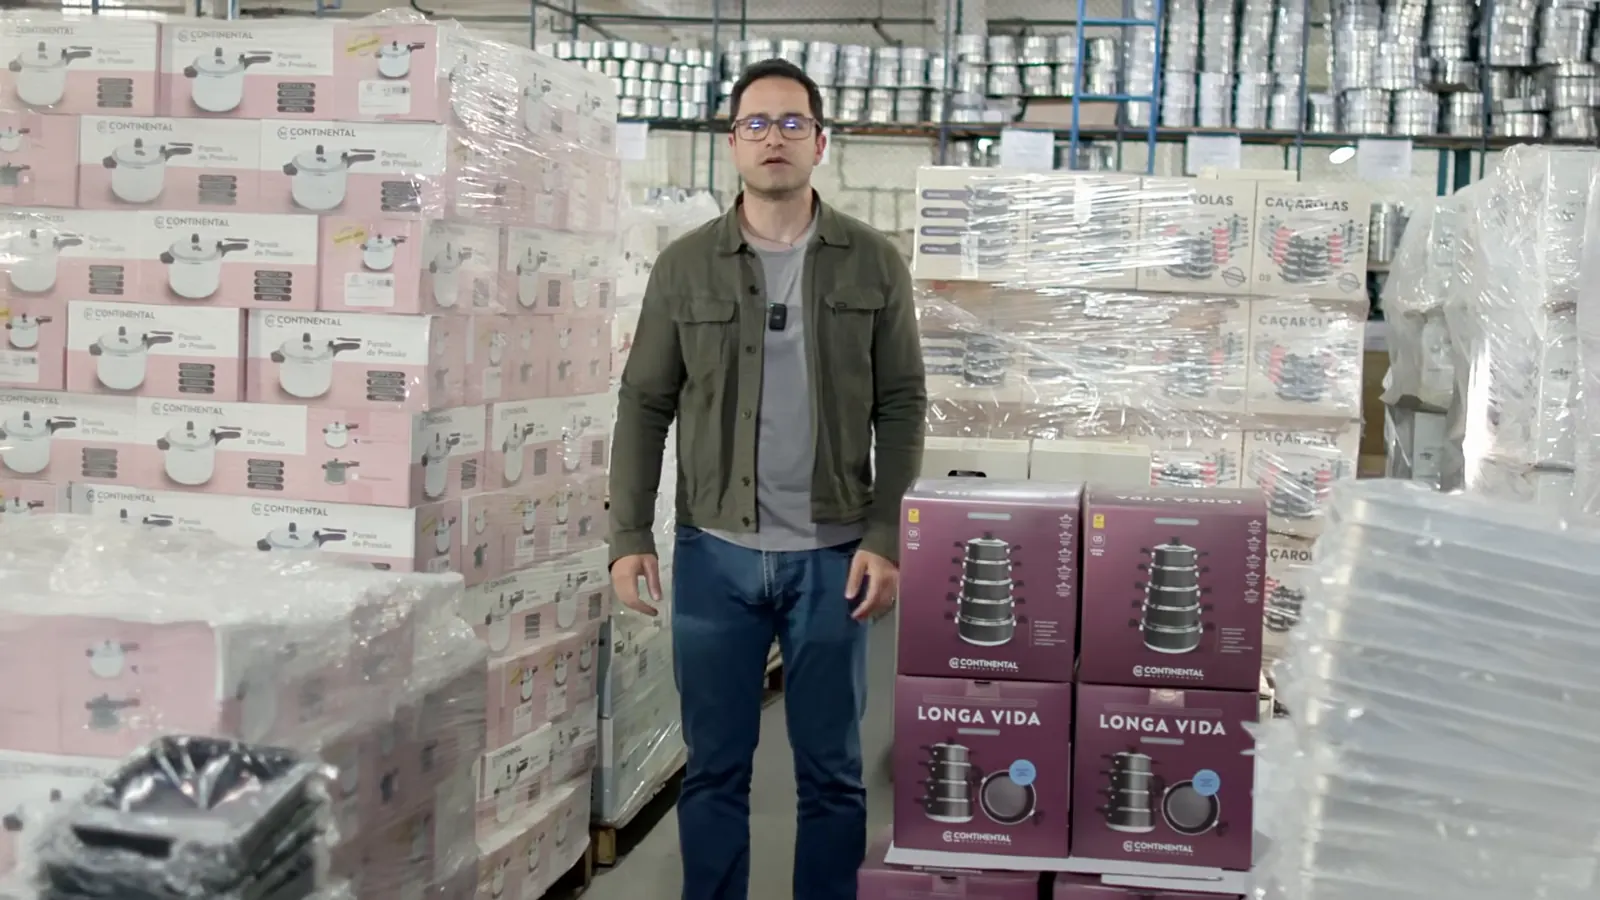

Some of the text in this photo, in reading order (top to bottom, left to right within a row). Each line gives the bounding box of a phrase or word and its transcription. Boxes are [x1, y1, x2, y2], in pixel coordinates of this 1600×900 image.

[190, 30, 255, 40] CONTINENTAL
[109, 121, 174, 133] CONTINENTAL
[290, 127, 357, 138] CONTINENTAL
[1265, 196, 1349, 211] CAÇAROLAS
[166, 216, 230, 228] CONTINENTAL
[95, 309, 156, 321] CONTINENTAL
[277, 315, 343, 327] CONTINENTAL
[367, 340, 392, 348] Panela
[163, 403, 225, 416] CONTINENTAL
[97, 491, 157, 504] CONTINENTAL
[264, 504, 329, 517] CONTINENTAL
[959, 658, 1019, 669] CONTINENTAL
[1144, 666, 1204, 678] CONTINENTAL
[918, 706, 1042, 726] LONGA VIDA
[1100, 714, 1227, 736] LONGA VIDA
[953, 831, 1012, 843] CONTINENTAL
[1133, 841, 1194, 853] CONTINENTAL
